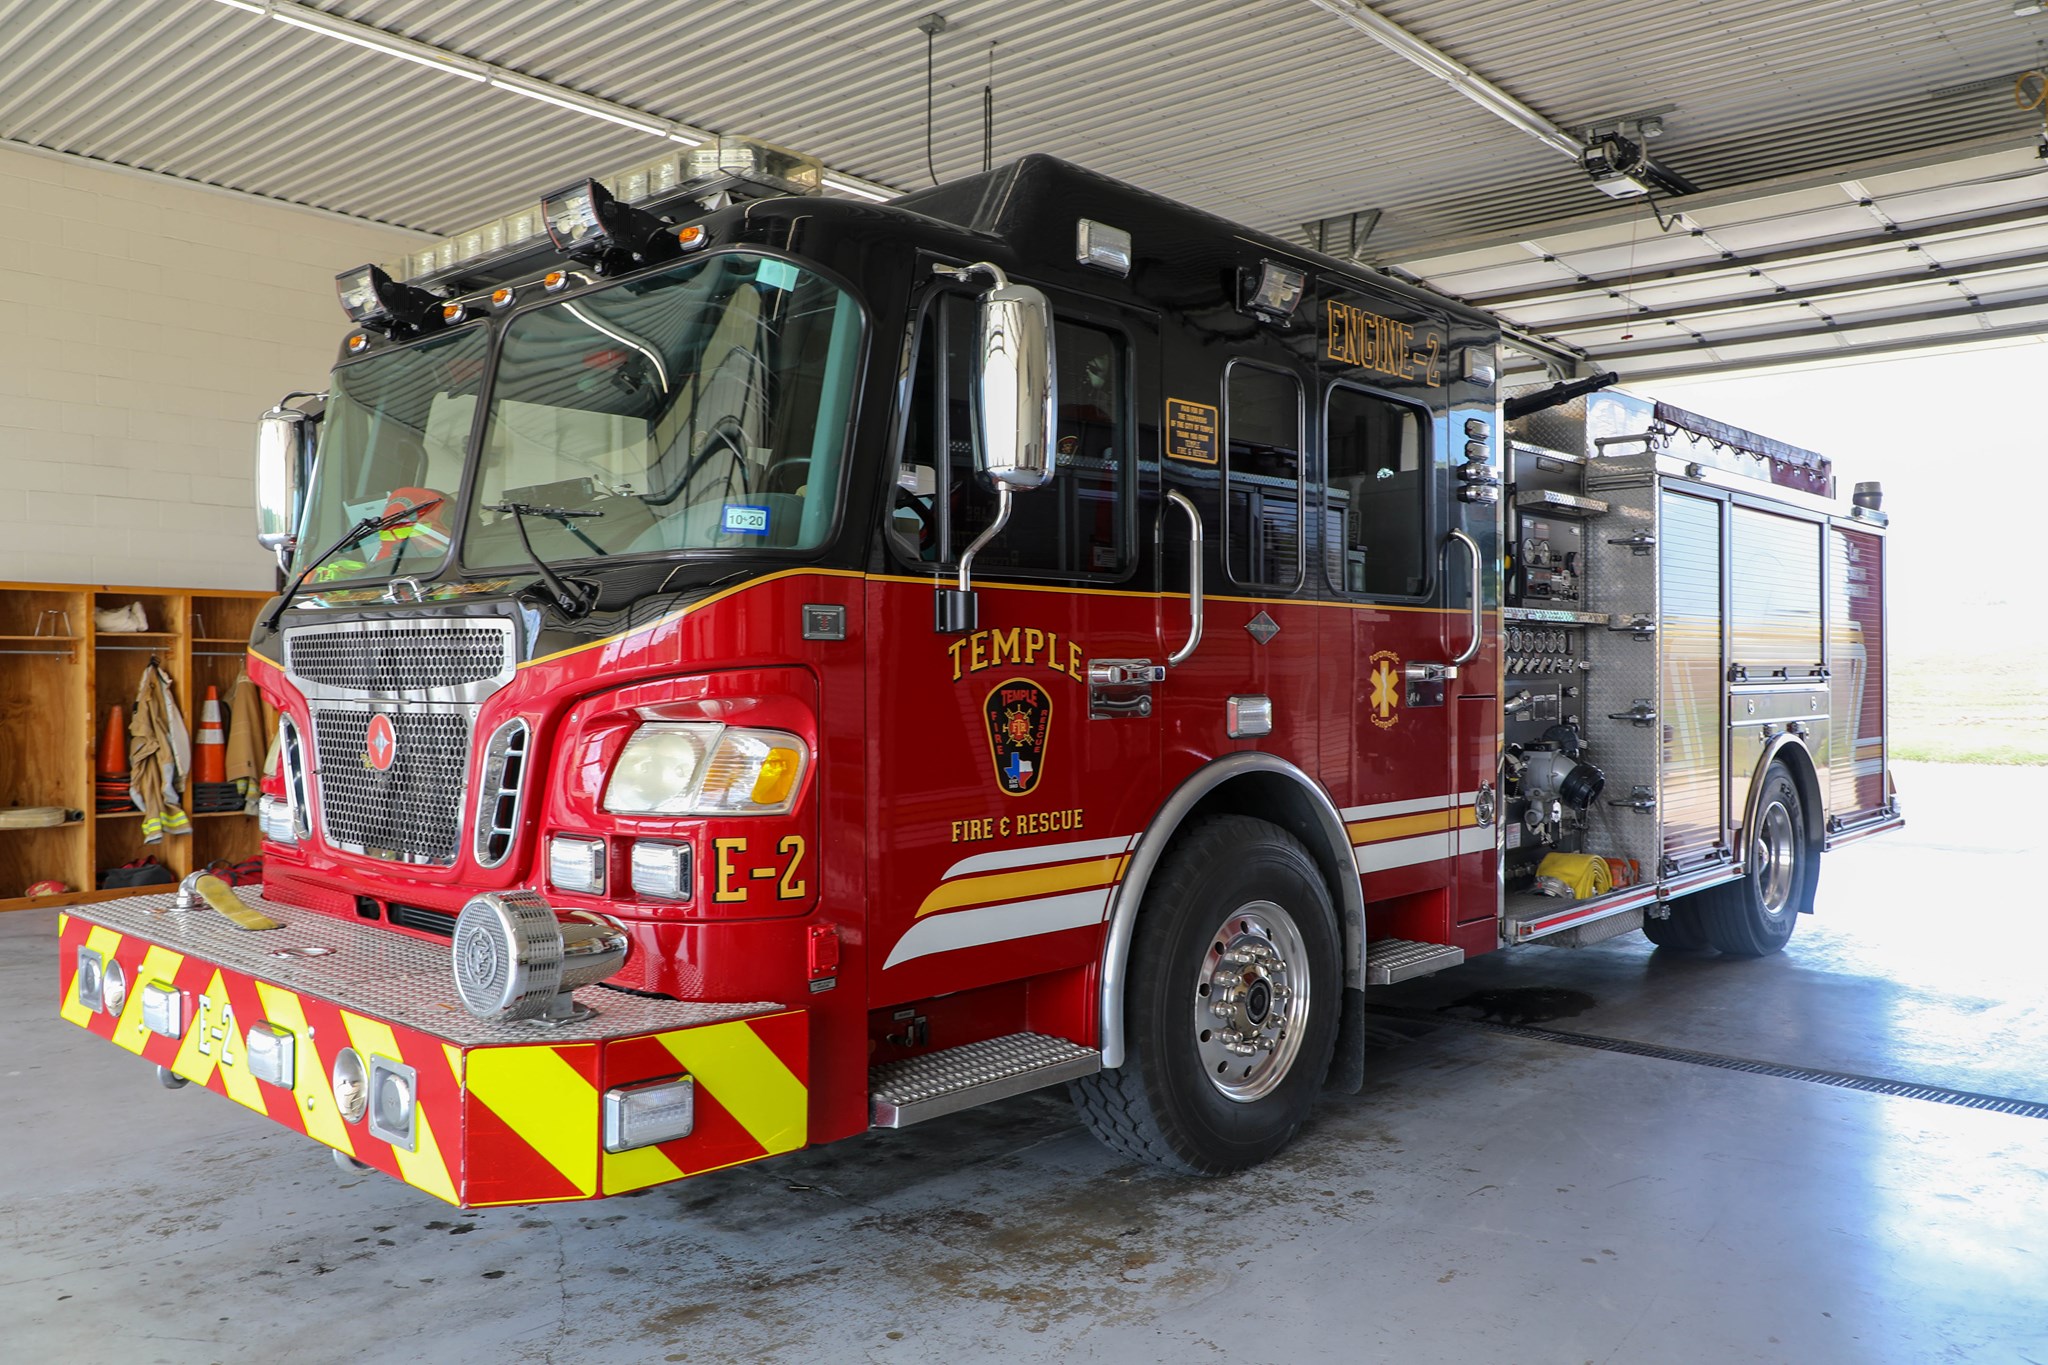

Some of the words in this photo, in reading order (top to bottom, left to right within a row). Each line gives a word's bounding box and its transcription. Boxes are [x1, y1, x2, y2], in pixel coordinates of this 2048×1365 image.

[1327, 300, 1440, 387] ENGINE-2
[948, 627, 1083, 683] TEMPLE
[1369, 650, 1400, 665] Paramedic
[1001, 689, 1038, 708] TEMPLE
[991, 711, 1005, 756] FIRE
[1371, 713, 1399, 731] Company
[951, 818, 994, 843] FIRE
[1016, 808, 1084, 836] RESCUE
[712, 835, 806, 904] E-2
[198, 994, 235, 1067] E-2
